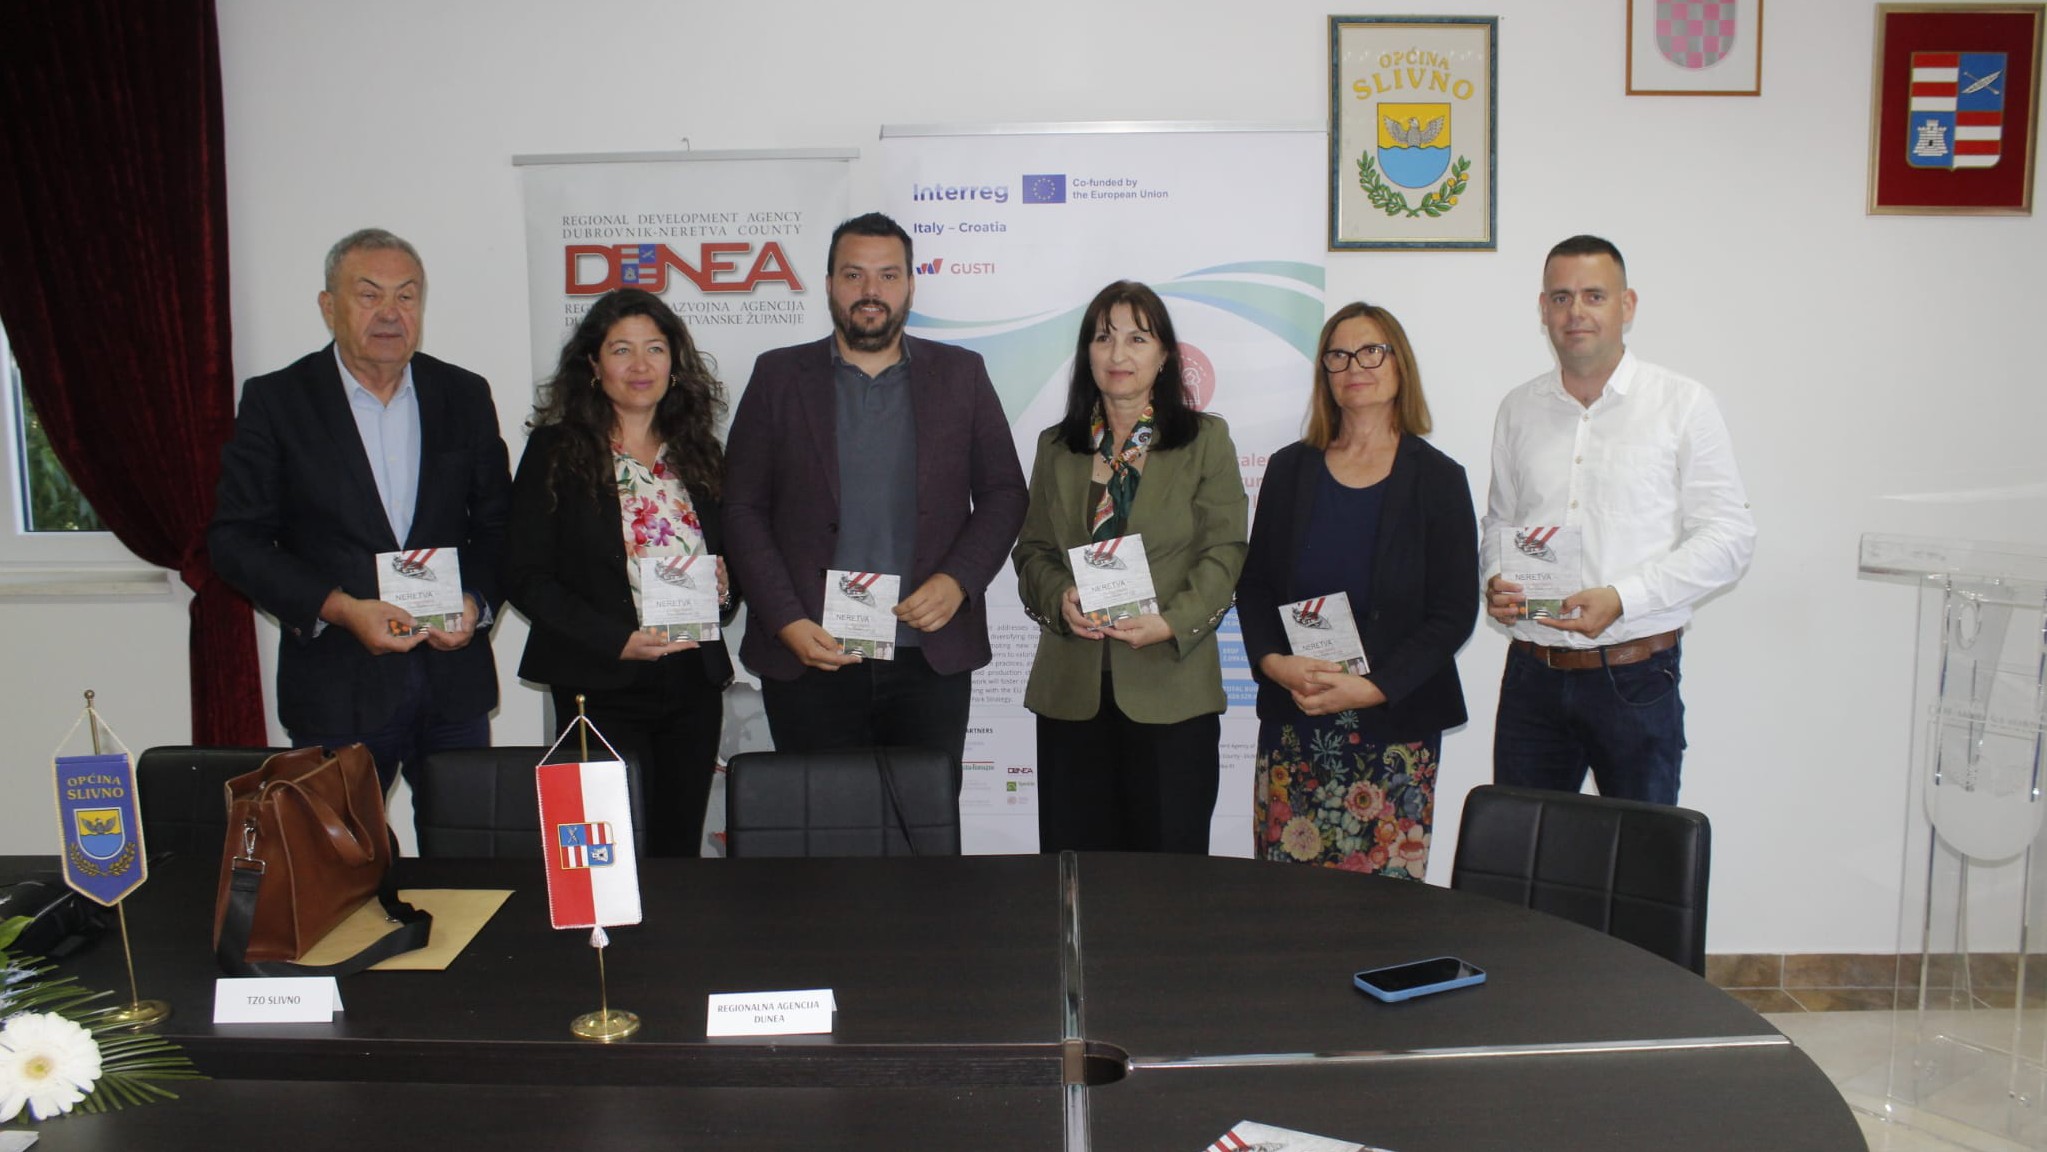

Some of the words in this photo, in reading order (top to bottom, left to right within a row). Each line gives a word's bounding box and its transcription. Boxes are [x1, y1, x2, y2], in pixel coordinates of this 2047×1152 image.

[1379, 47, 1449, 69] OPĆINA
[1352, 68, 1475, 101] SLIVNO
[1073, 178, 1123, 187] Co-funded
[1126, 178, 1138, 188] by
[914, 184, 1009, 203] Interreg
[1073, 190, 1088, 199] the
[1091, 190, 1137, 200] European
[1140, 190, 1168, 198] Union
[562, 215, 629, 226] REGIONAL
[638, 212, 739, 224] DEVELOPMENT
[747, 211, 803, 222] AGENCY
[562, 226, 728, 239] DUBROVNIK-NERETVA
[737, 224, 803, 236] COUNTY
[914, 222, 944, 235] Italy
[959, 221, 1007, 232] Croatia
[950, 263, 995, 274] GUSTI
[673, 301, 730, 312] AZVOJNA
[740, 300, 805, 312] AGENCIJA
[746, 312, 805, 325] ŽUPANIJE
[1515, 573, 1552, 581] NERETVA
[1091, 581, 1126, 592] NERETVA
[395, 591, 433, 601] NERETVA
[656, 600, 692, 608] NERETVA
[836, 614, 870, 623] NERETVA
[66, 772, 122, 787] OPĆINA
[67, 787, 125, 800] SLIVNO
[247, 996, 265, 1005] TZO
[268, 995, 301, 1004] SLIVNO
[717, 1003, 775, 1013] REGIONALNA
[777, 1000, 820, 1010] AGENCIJA
[754, 1014, 785, 1023] DUNEA
